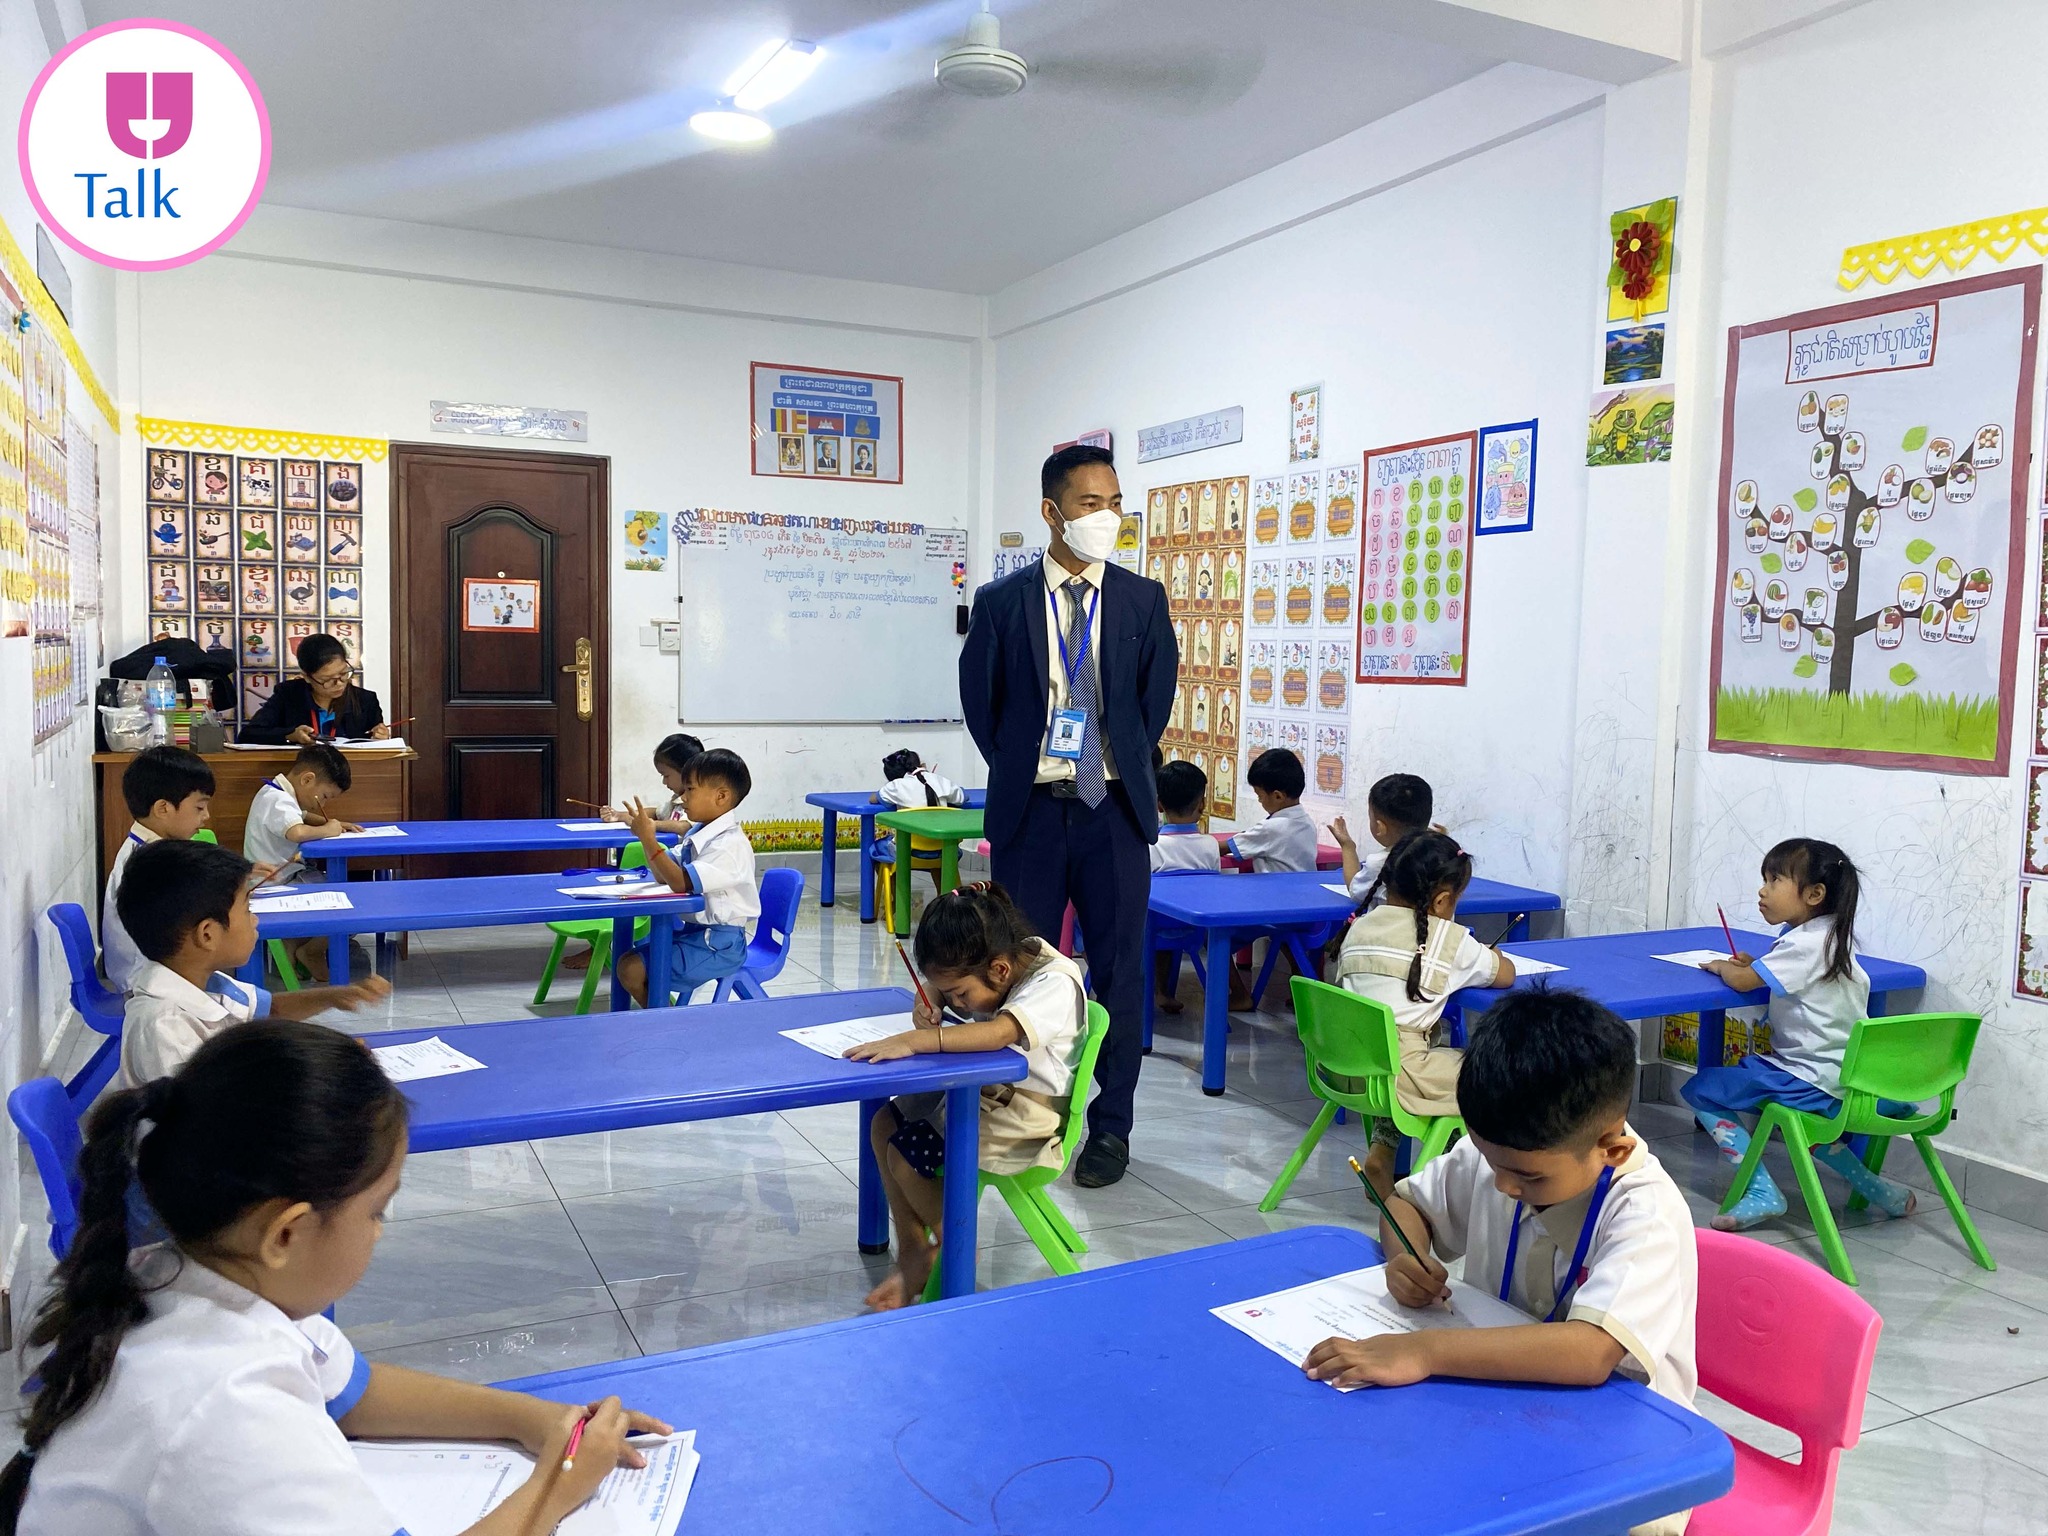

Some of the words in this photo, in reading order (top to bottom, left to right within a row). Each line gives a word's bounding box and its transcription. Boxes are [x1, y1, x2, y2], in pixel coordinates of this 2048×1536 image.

[1794, 312, 1932, 379] រុក្ខជាតិសម្រាប់ហូបផ្លែ
[777, 395, 792, 405] ជាតិ
[796, 398, 823, 408] សាសនា
[159, 454, 177, 467] ក
[205, 458, 220, 470] ខ
[249, 462, 266, 475] គ
[290, 465, 312, 477] ឃ
[337, 466, 350, 479] ង
[1374, 488, 1381, 505] ក
[1393, 487, 1400, 501] ខ
[1412, 482, 1420, 498] គ
[1430, 480, 1440, 494] ឃ
[161, 509, 175, 522] ច
[206, 512, 220, 525] ឆ
[250, 514, 264, 529] ជ
[1372, 515, 1380, 527] ច
[1391, 511, 1399, 526] ឆ
[1411, 504, 1417, 524] ជ
[1428, 505, 1439, 520] ឈ
[1450, 503, 1461, 523] ញ
[289, 517, 313, 530] ឈ
[333, 519, 352, 534] ញ
[1409, 530, 1416, 547] ឌ
[1448, 529, 1462, 543] ណ
[1370, 559, 1378, 574] ត
[1388, 555, 1396, 573] ថ
[1407, 557, 1414, 571] ទ
[1428, 555, 1438, 570] ធ
[1451, 549, 1458, 567] ន
[160, 564, 176, 577] ដ
[204, 567, 224, 580] ឋ
[249, 568, 268, 581] ឌ
[289, 570, 313, 582] ឍ
[331, 572, 357, 584] ណ
[1368, 584, 1376, 599] ប
[1386, 579, 1394, 597] ផ
[1406, 581, 1414, 596] ព
[1428, 578, 1437, 595] ភ
[1450, 578, 1459, 592] ម
[1365, 608, 1374, 621] យ
[1387, 606, 1392, 620] រ
[1405, 607, 1414, 620] ល
[1430, 602, 1436, 620] វ
[1449, 601, 1459, 619] ស
[160, 619, 179, 631] ត
[206, 621, 224, 634] ថ
[251, 621, 267, 634] ទ
[294, 624, 310, 636] ធ
[336, 624, 351, 636] ន
[1366, 630, 1375, 644] ហ
[1404, 630, 1413, 643] អ
[252, 674, 269, 688] ព
